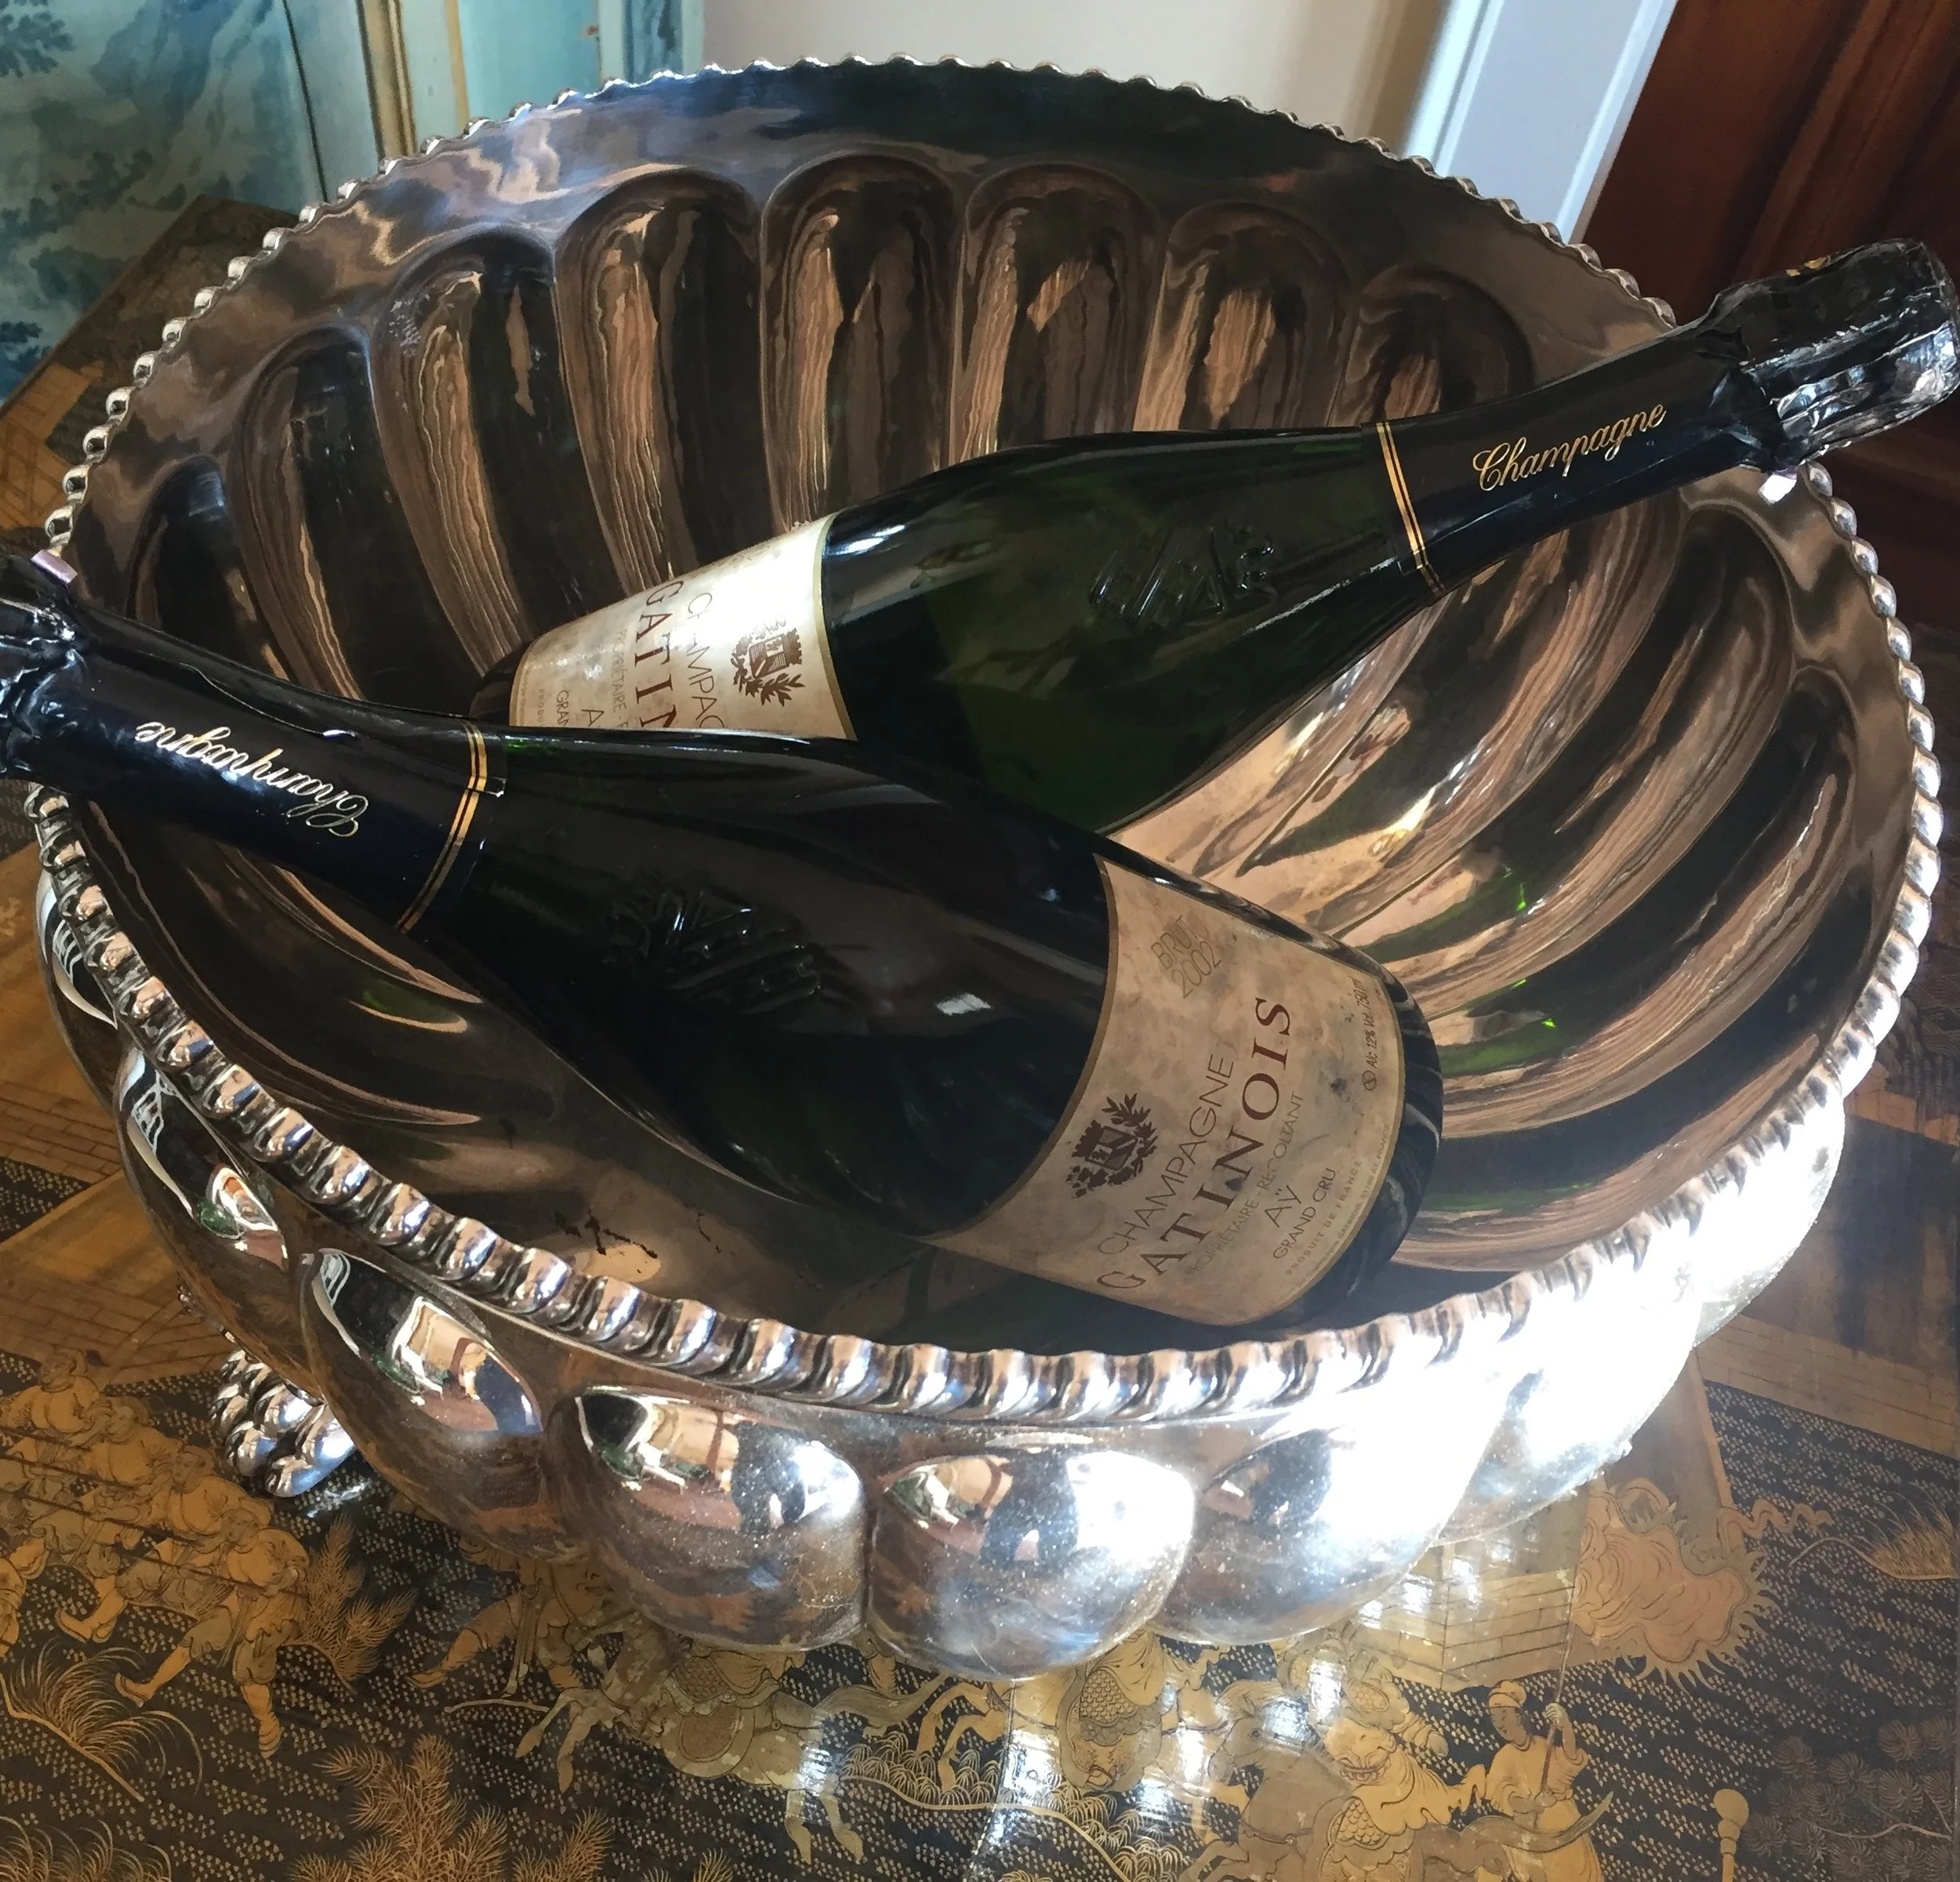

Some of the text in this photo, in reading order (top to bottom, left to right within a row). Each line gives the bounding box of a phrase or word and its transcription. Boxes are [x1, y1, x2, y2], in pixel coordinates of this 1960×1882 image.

[1472, 402, 1666, 491] Champagne
[135, 721, 368, 838] Champagne
[1151, 916, 1200, 970] BRUT
[1171, 940, 1222, 999] 2002
[1363, 1030, 1377, 1049] 12%
[1366, 1052, 1377, 1069] Alc
[1097, 997, 1290, 1290] GATINOIS
[1098, 1054, 1234, 1256] CHAMPAGNE
[1272, 1206, 1316, 1260] GRAND
[1312, 1168, 1336, 1202] CRU
[1286, 1231, 1324, 1275] PRODUIT
[1335, 1160, 1363, 1209] FRANCE
